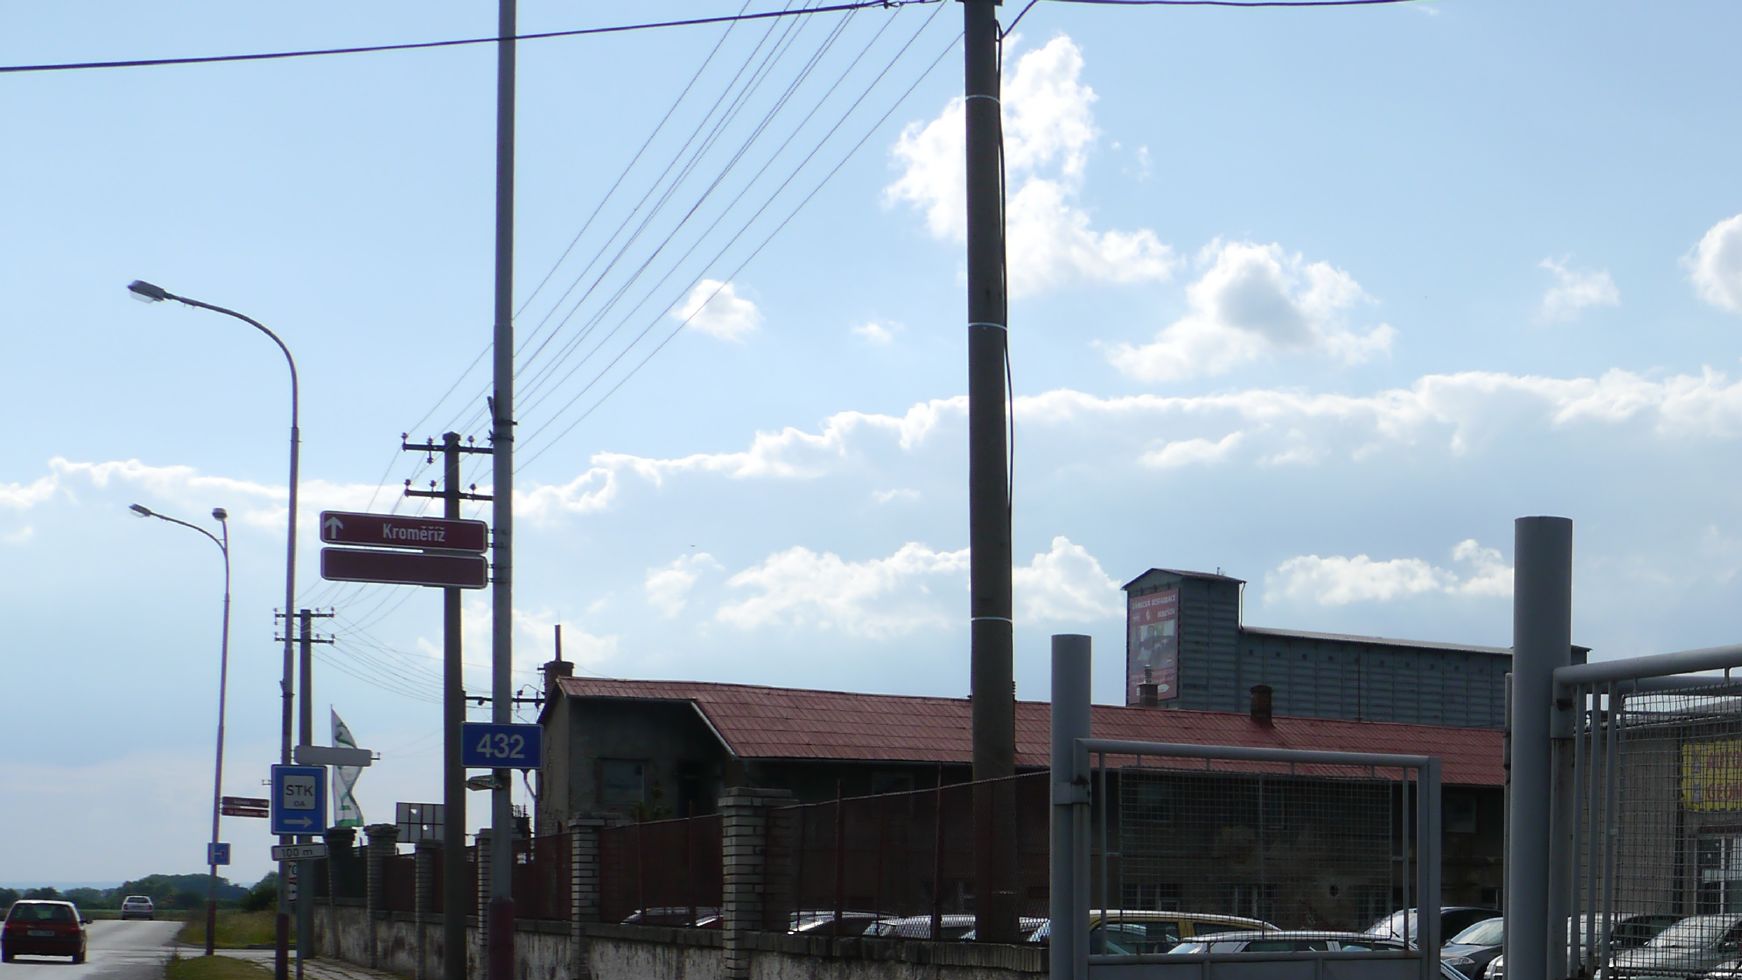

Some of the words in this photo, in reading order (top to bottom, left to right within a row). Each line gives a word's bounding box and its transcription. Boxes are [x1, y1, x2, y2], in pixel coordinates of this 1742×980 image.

[382, 523, 446, 543] Kroměříž
[476, 733, 525, 759] 432
[285, 784, 313, 797] STK
[281, 847, 299, 858] 100
[302, 848, 313, 856] m
